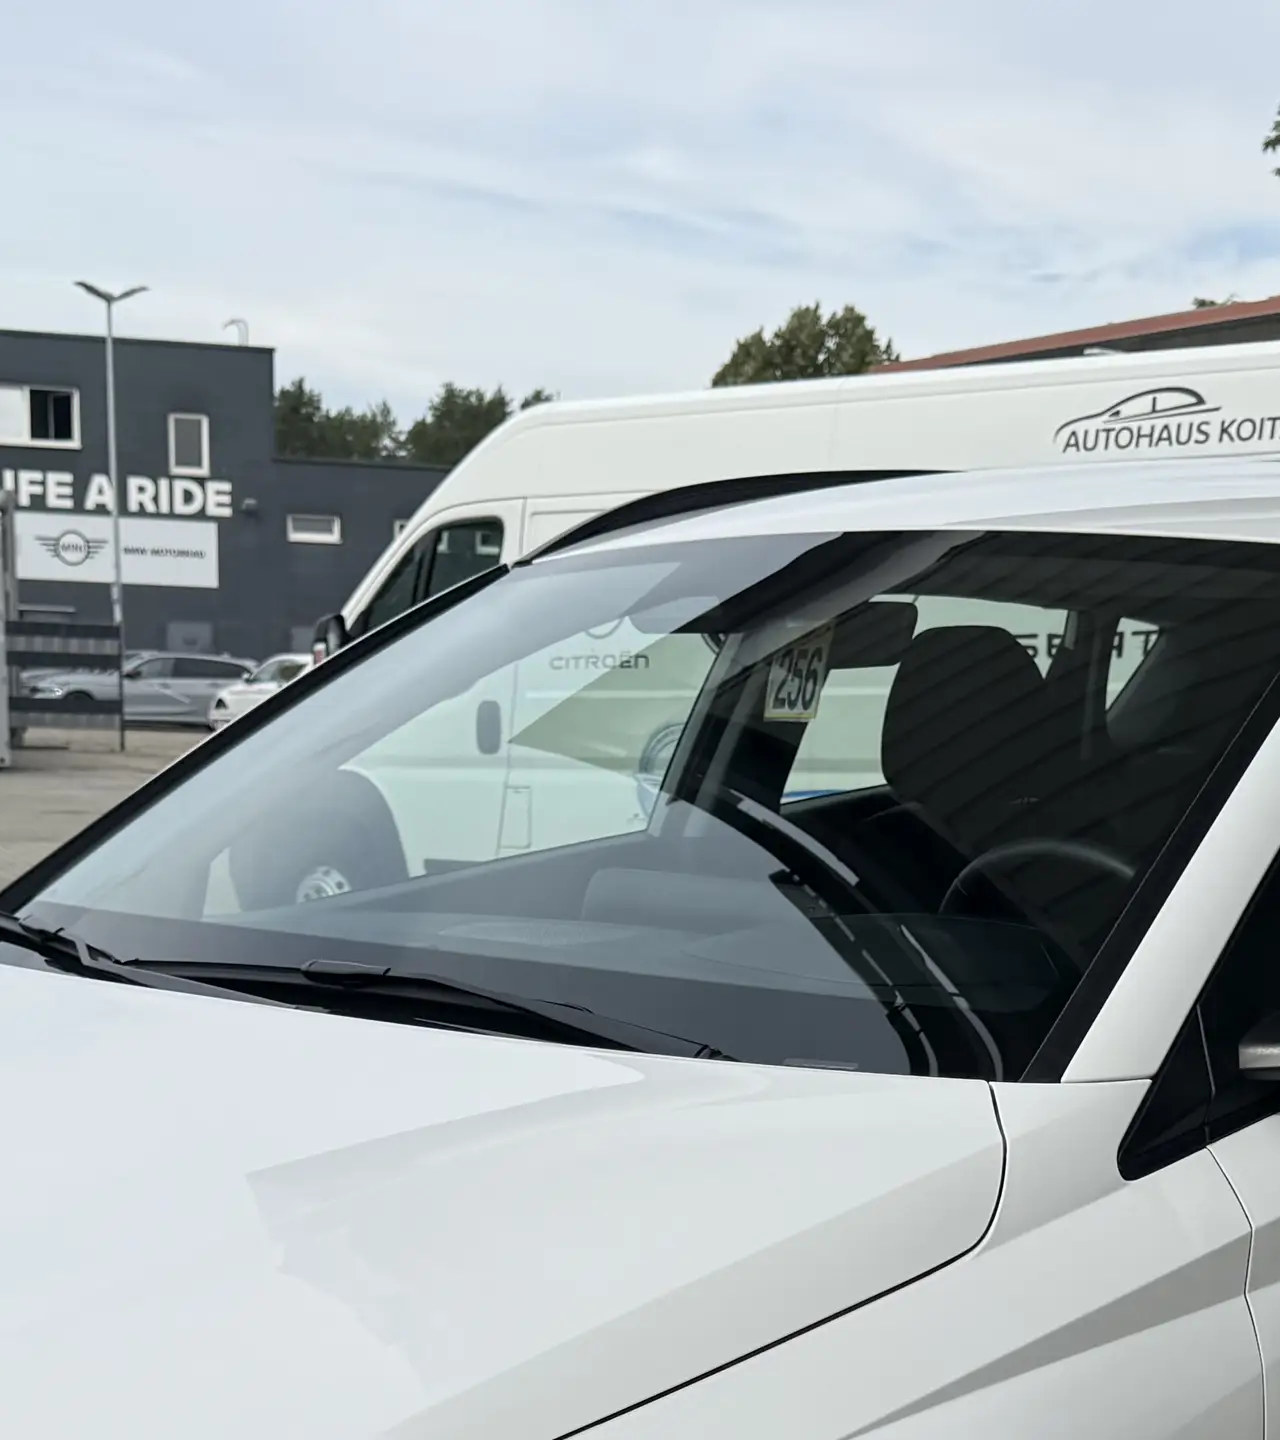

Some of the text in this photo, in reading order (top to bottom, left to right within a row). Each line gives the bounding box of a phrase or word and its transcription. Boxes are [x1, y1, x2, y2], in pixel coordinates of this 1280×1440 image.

[1062, 420, 1211, 454] AUTOHAUS
[85, 473, 116, 512] A
[126, 475, 233, 518] RIDE
